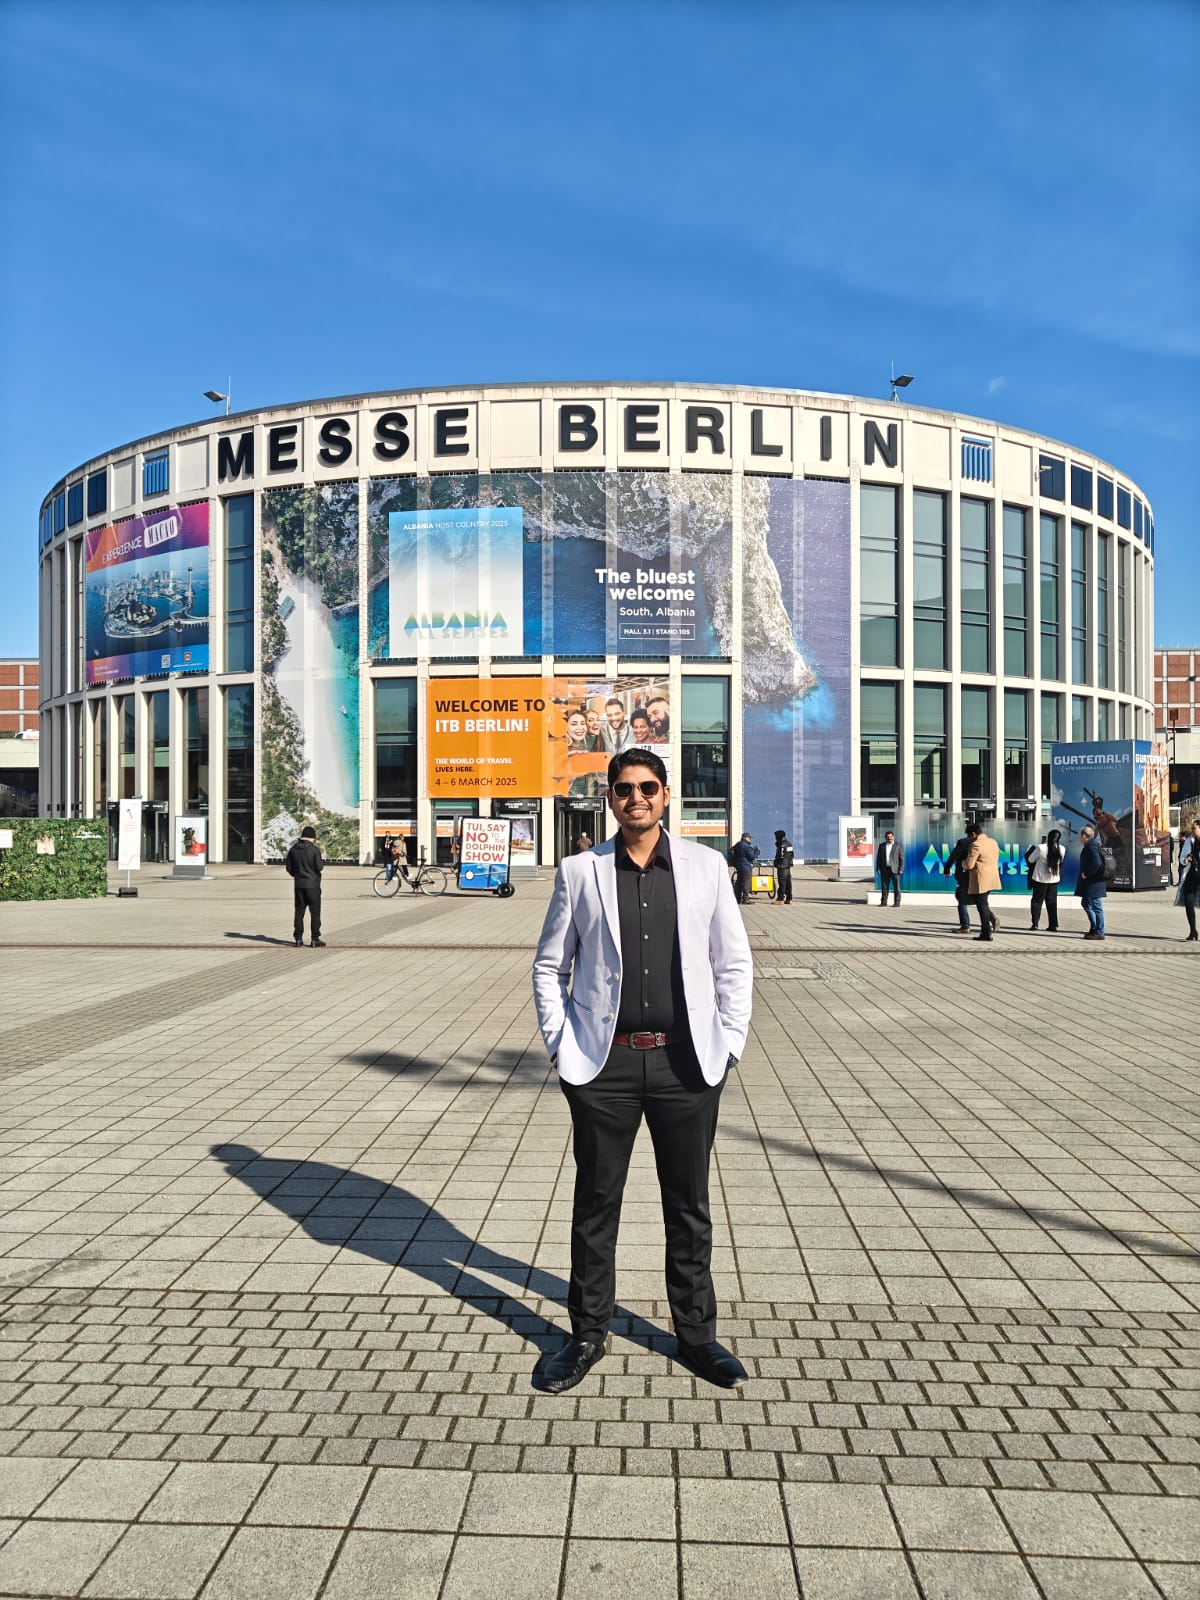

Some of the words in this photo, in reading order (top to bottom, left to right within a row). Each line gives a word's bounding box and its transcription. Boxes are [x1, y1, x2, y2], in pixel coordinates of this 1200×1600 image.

[218, 408, 469, 481] MESSE
[561, 404, 898, 467] BERLIN
[102, 536, 143, 564] EXPERIENCE
[148, 519, 175, 545] MACAO
[595, 568, 631, 584] The
[636, 568, 695, 584] bluest
[610, 585, 695, 601] welcome
[619, 607, 653, 617] South,
[656, 607, 695, 617] Albania
[403, 610, 508, 629] ALBANIA
[436, 699, 518, 713] WELCOME
[524, 699, 545, 712] TO
[436, 719, 460, 733] ITB
[465, 719, 529, 732] BERLIN!
[1053, 754, 1130, 766] GUATEMALA
[435, 778, 441, 786] 4
[458, 778, 493, 786] MARCH
[495, 777, 517, 785] 2025
[467, 822, 485, 833] TUI,
[487, 823, 506, 833] SAY
[466, 832, 489, 843] NO
[465, 843, 505, 852] DOLPHIN
[465, 851, 505, 862] SHOW
